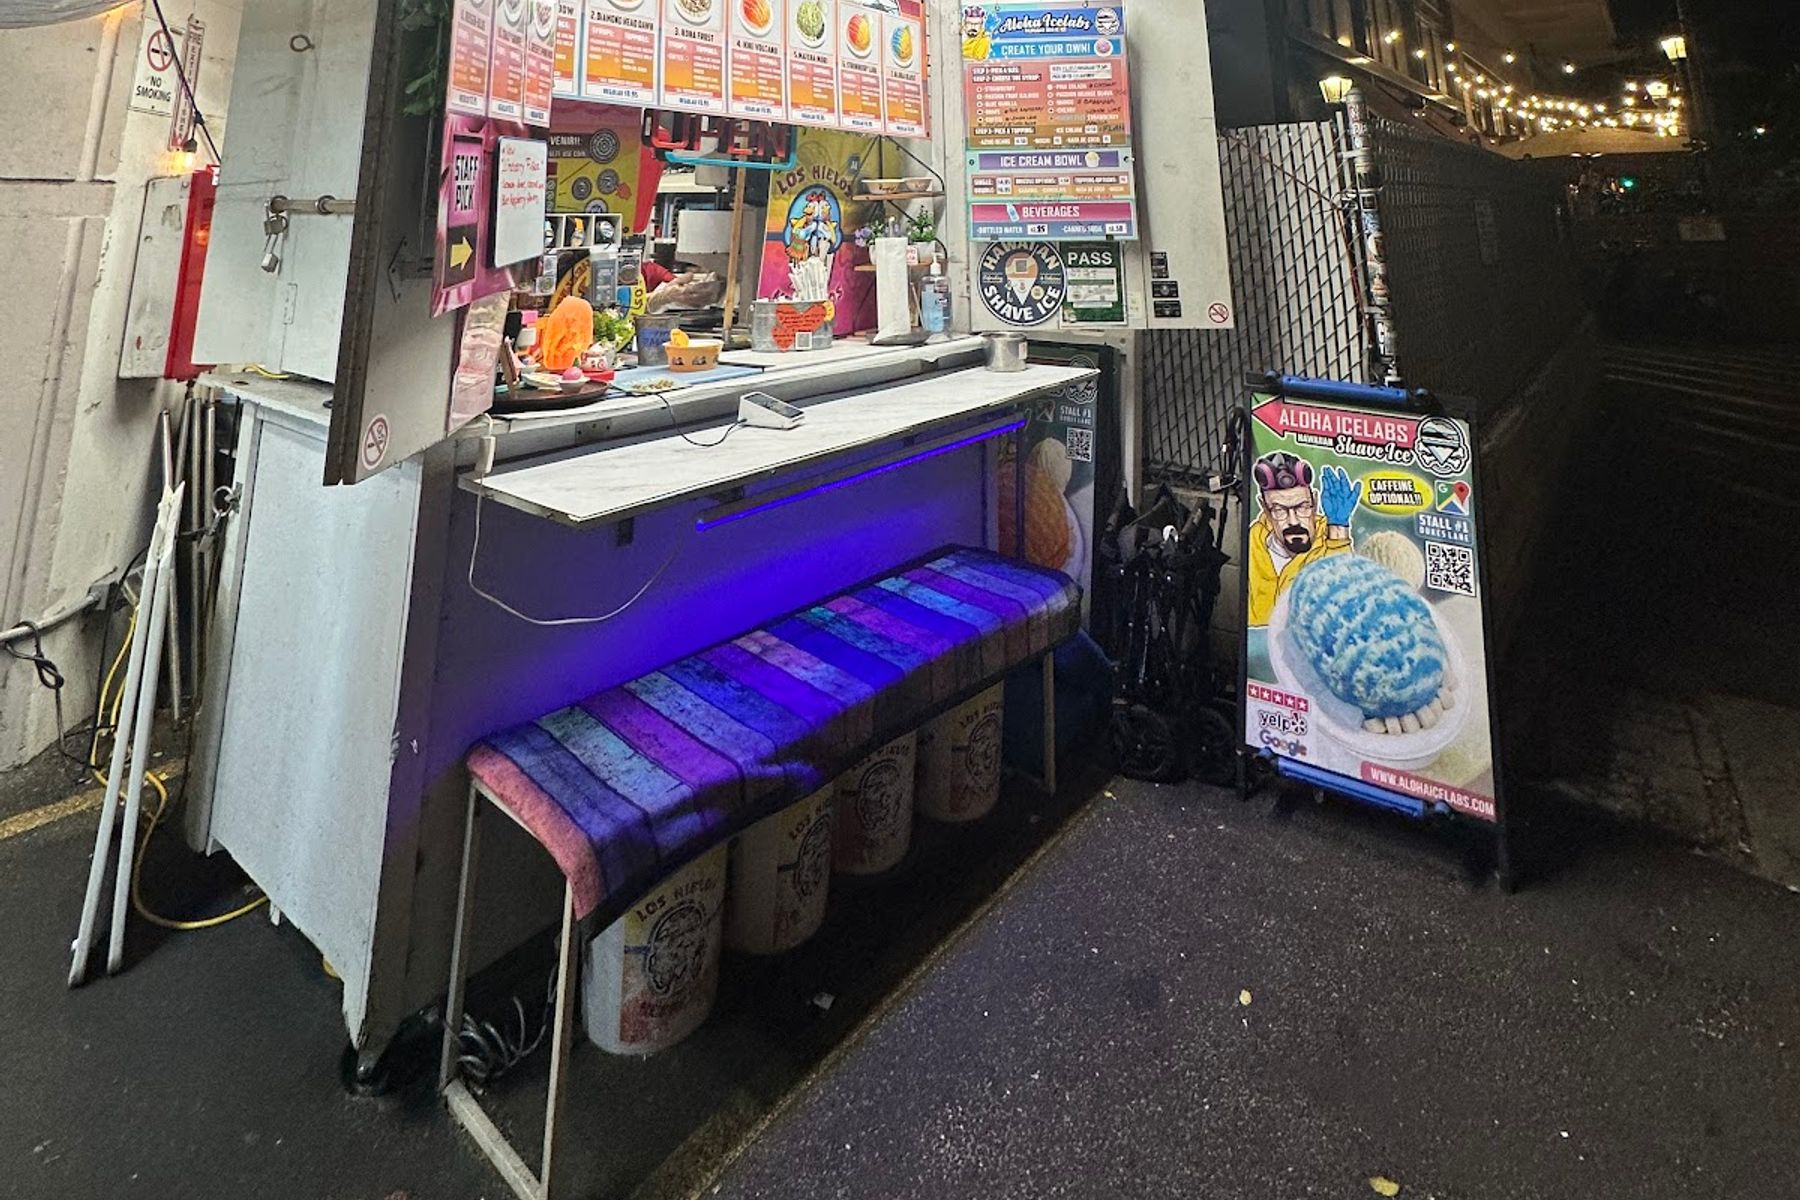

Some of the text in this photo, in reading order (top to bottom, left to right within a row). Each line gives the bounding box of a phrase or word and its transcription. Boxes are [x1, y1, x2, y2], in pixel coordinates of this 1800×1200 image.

[999, 16, 1043, 33] Aloha
[1002, 41, 1091, 56] CREATE YOUR OWN!
[150, 76, 163, 88] NO
[136, 85, 172, 102] SMOKING
[455, 154, 479, 182] STAFF
[1001, 153, 1083, 168] ICE CREAM BOWL
[776, 165, 852, 198] LOS HIELOS
[454, 183, 476, 211] PICK
[1022, 205, 1080, 218] BEVERAGES
[1067, 250, 1113, 266] PASS
[983, 284, 1033, 321] SHAVE
[1036, 285, 1061, 315] ICE
[1061, 405, 1081, 417] STALL
[1279, 409, 1408, 443] ALOHA ICELABS
[1336, 435, 1386, 457] Shave
[1384, 444, 1411, 461] Ice
[1370, 480, 1414, 491] CAFFEINE
[1419, 514, 1469, 533] STALL #1
[1448, 530, 1469, 543] LANE
[1260, 713, 1291, 732] yelp
[1260, 730, 1307, 756] Google
[1370, 766, 1495, 816] WWW.ALOHAICELABS.COM
[636, 895, 667, 921] LOS
